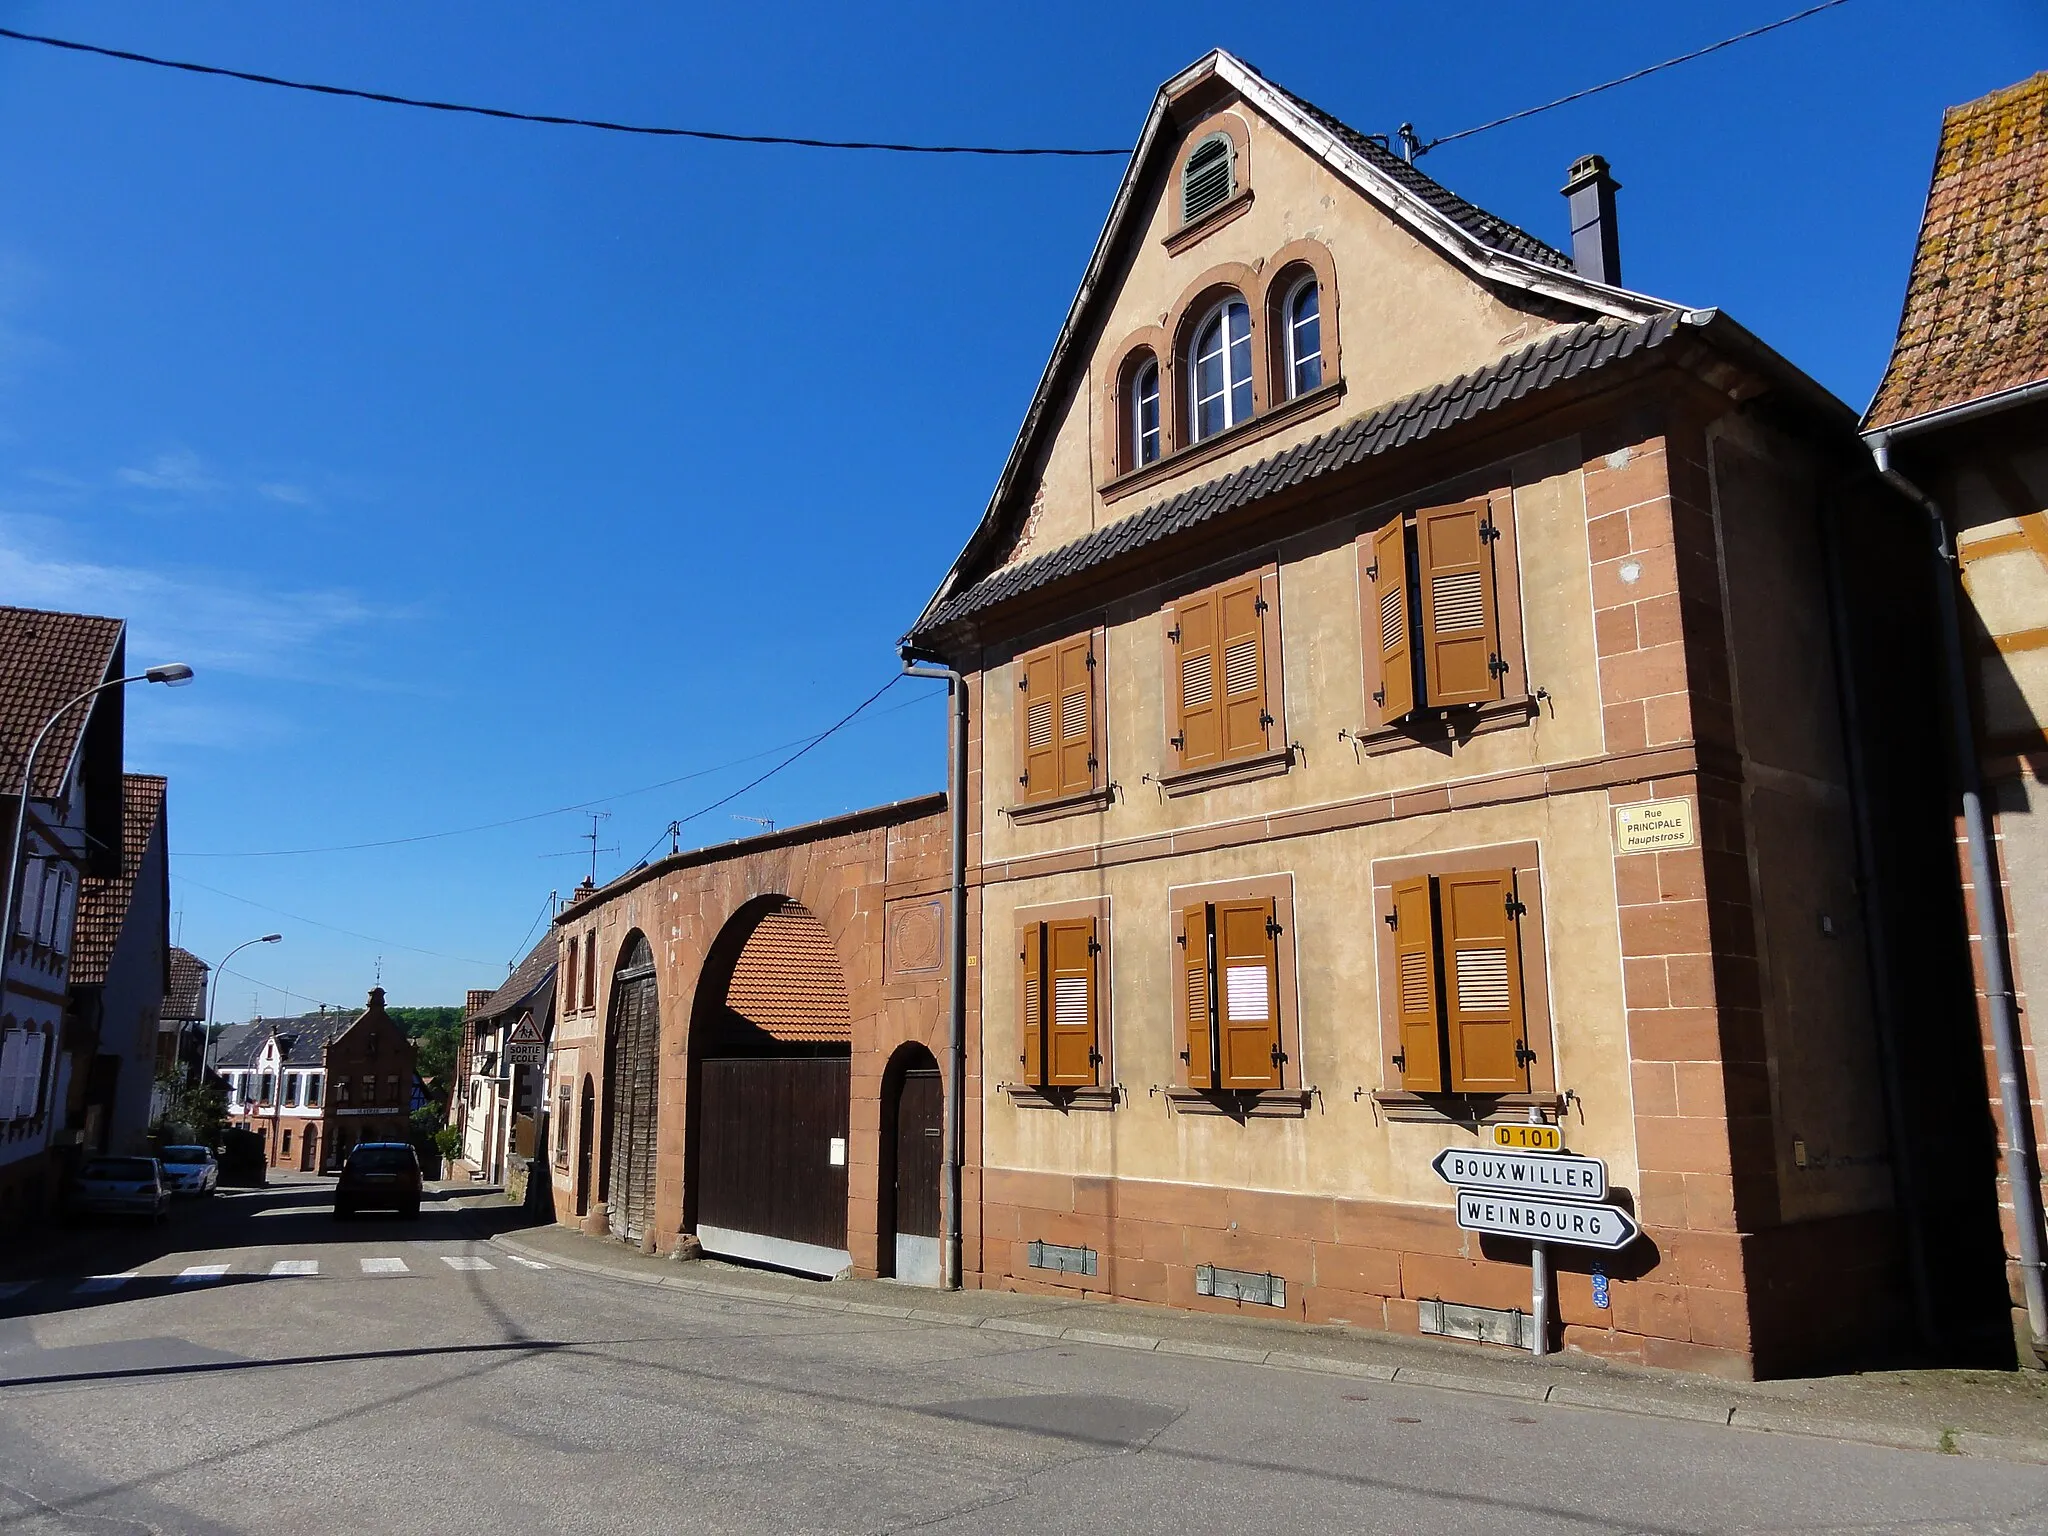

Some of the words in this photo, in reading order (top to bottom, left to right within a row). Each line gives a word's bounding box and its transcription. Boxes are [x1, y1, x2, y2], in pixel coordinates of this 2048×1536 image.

[1644, 810, 1662, 819] Rue
[1627, 819, 1682, 832] PRINCIPALE
[1628, 832, 1685, 845] Hauptstross
[510, 1046, 541, 1054] SORTIE
[511, 1055, 538, 1063] ECOLE
[1500, 1128, 1511, 1144] D
[1520, 1130, 1555, 1147] 101
[1455, 1159, 1594, 1188] BOUXWILLER
[1467, 1202, 1601, 1235] WEINBOURG
